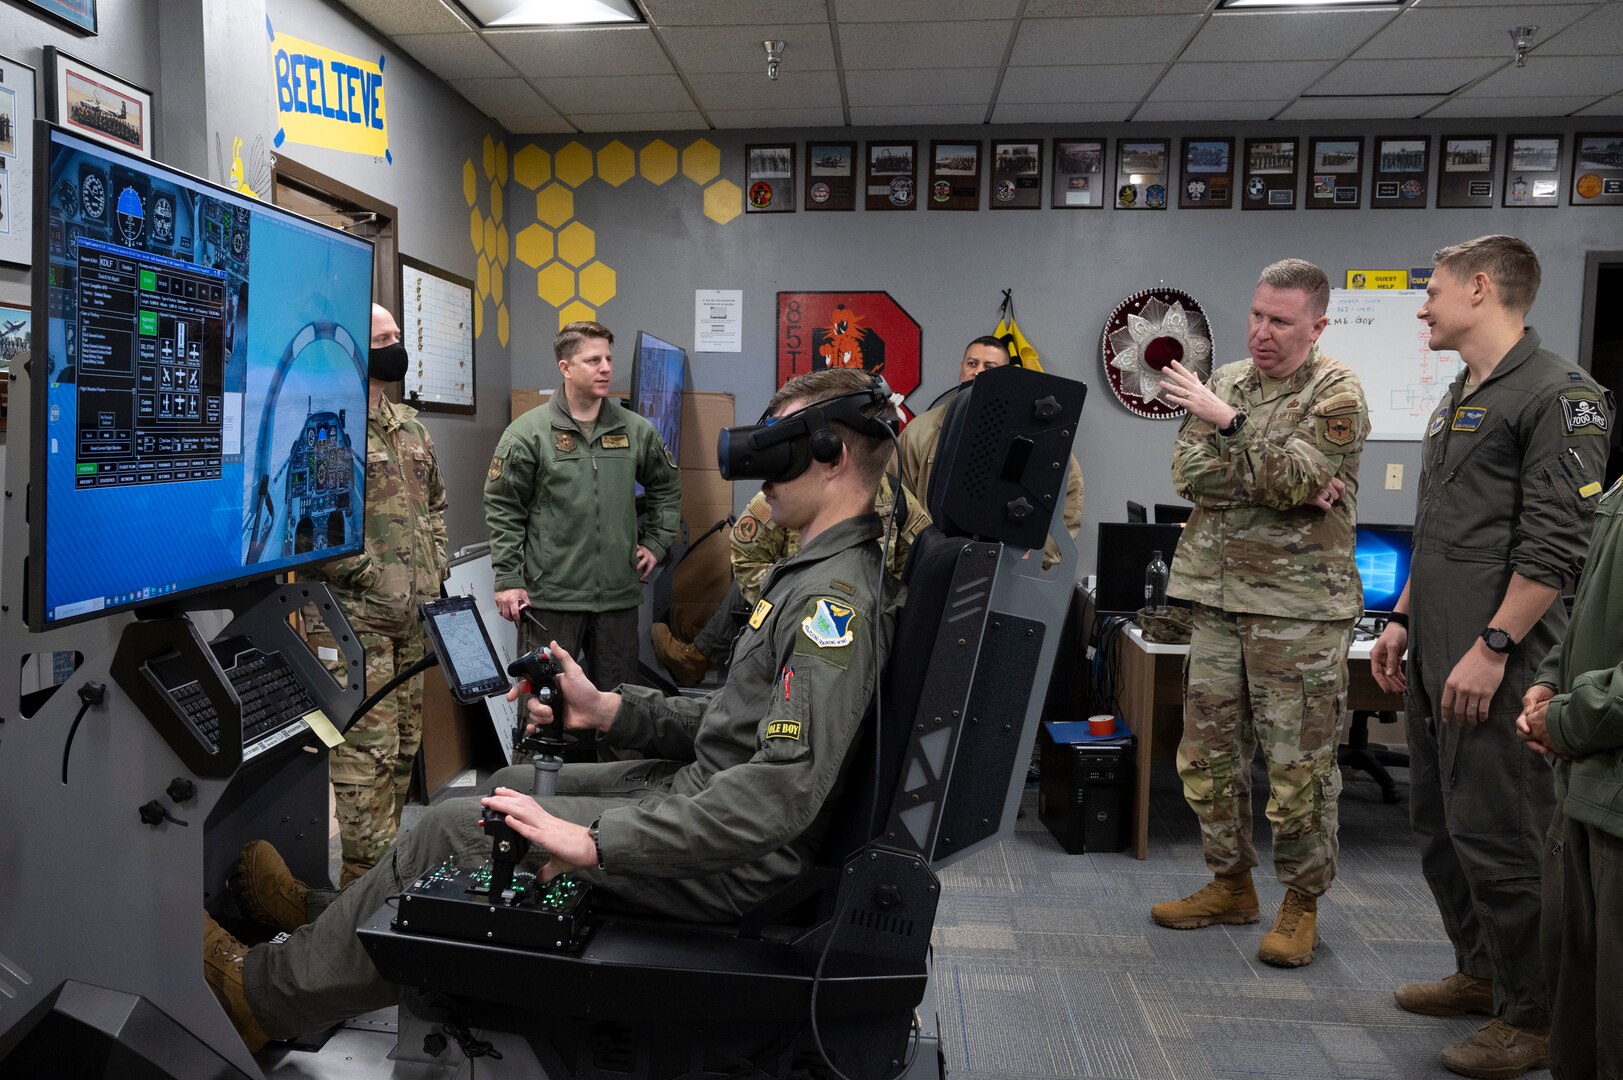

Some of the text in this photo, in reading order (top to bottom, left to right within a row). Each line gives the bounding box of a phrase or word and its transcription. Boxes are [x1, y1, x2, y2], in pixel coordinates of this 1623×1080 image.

[274, 48, 384, 130] BEELIEVE
[100, 258, 114, 268] KDLF
[1328, 315, 1375, 326] IME.GOV
[786, 300, 801, 382] 85T
[1572, 414, 1605, 426] 1000 HRS
[782, 724, 798, 735] BOY
[269, 932, 292, 944] VER
